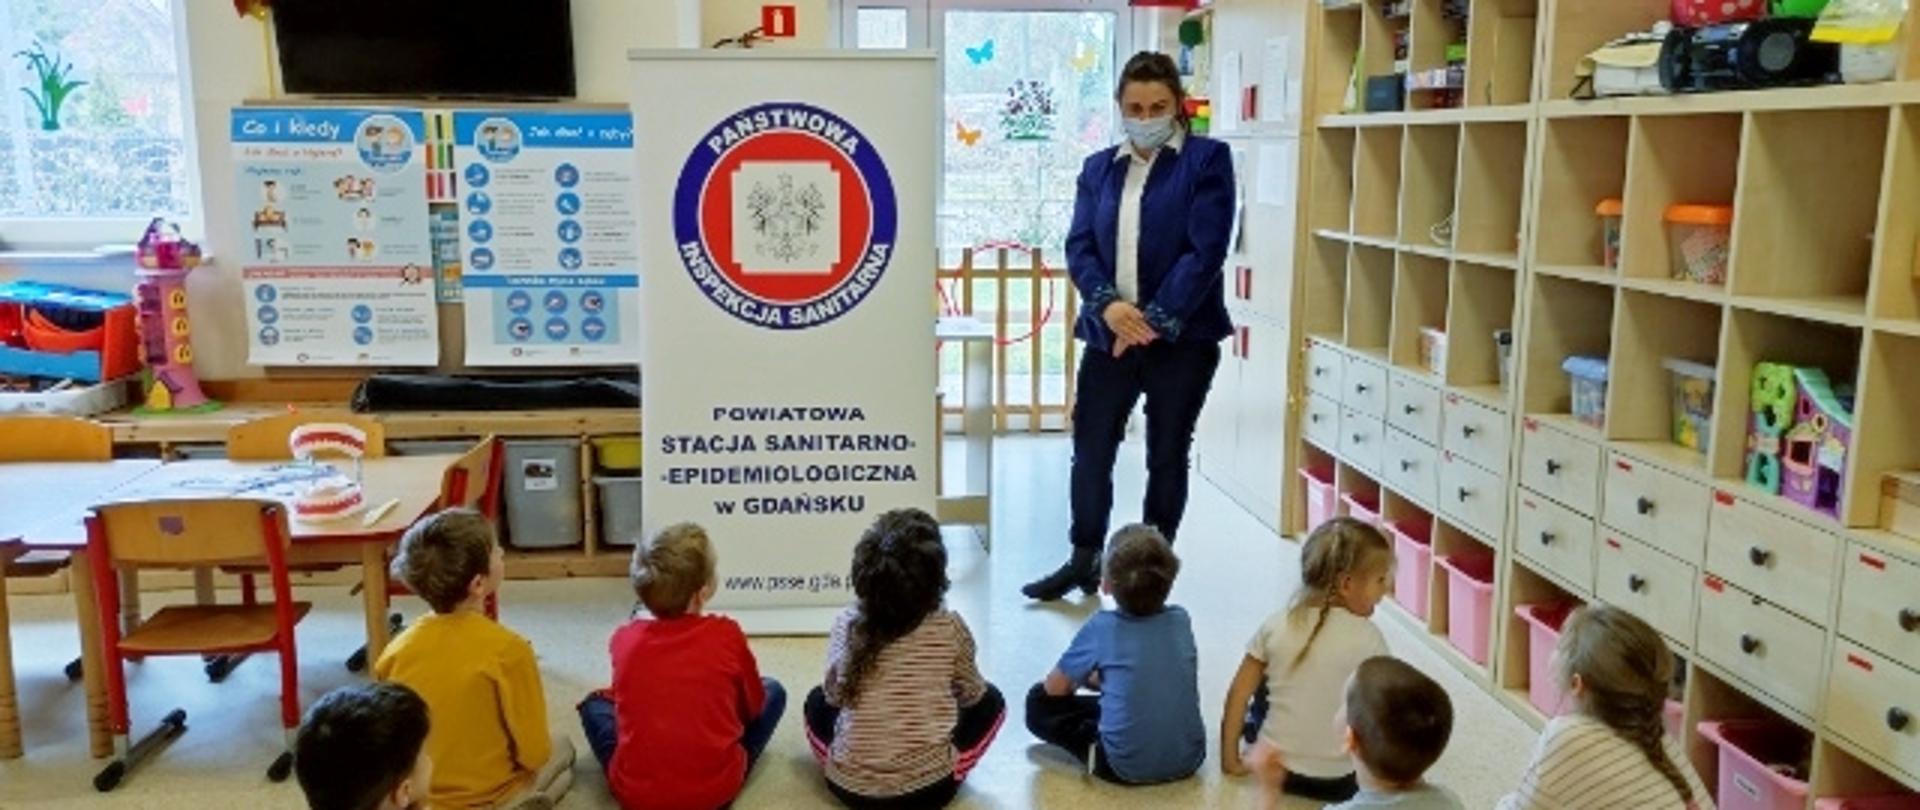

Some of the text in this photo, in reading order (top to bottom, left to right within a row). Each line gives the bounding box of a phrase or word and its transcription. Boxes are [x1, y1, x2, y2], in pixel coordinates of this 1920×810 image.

[243, 119, 267, 135] Co
[290, 118, 341, 140] kiedy
[707, 109, 860, 155] PAŃSTWOWA
[680, 241, 890, 326] INSPEKCJA SANITARNA
[712, 407, 866, 421] POWIATOWA
[661, 434, 916, 454] STACJA SANITARNO-
[660, 464, 918, 485] -EPIDEMIOLOGICZNA
[743, 493, 866, 515] GDAŃSKU
